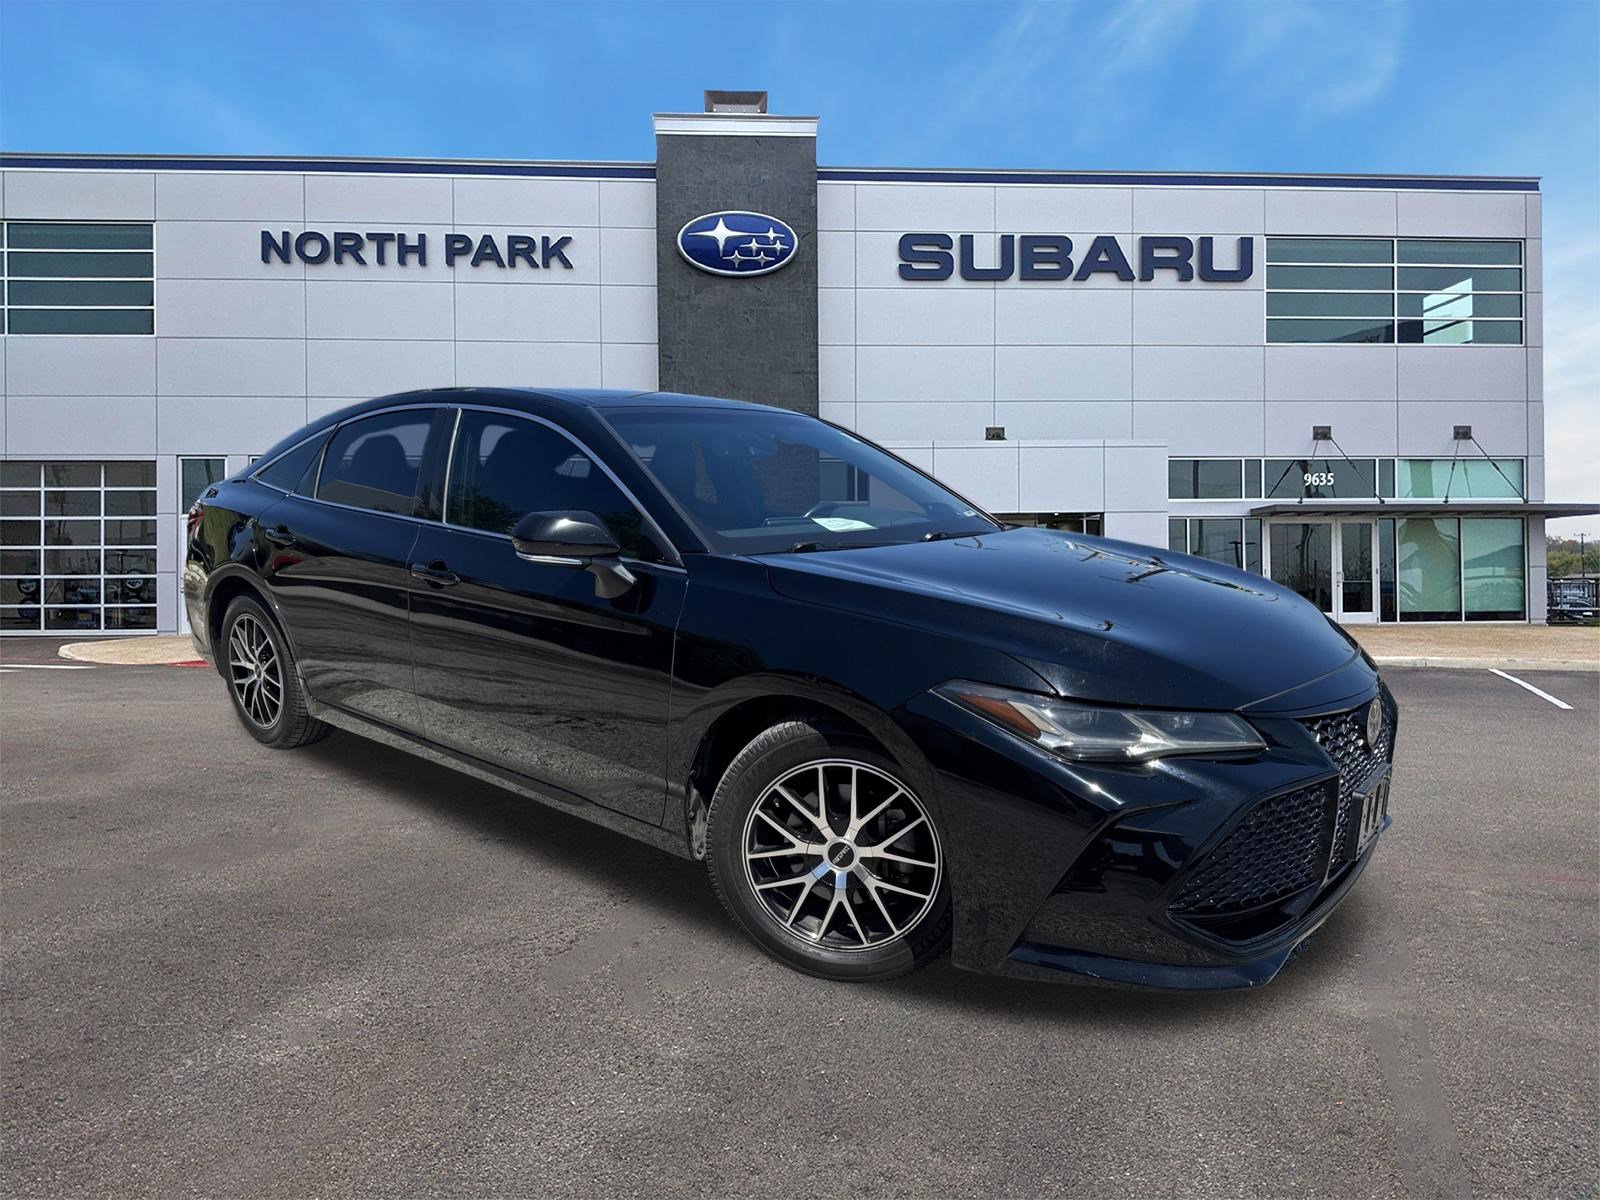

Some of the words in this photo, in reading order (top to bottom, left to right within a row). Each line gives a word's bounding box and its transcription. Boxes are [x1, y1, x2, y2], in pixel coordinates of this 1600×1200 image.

[261, 230, 427, 266] NORTH
[445, 233, 573, 269] PARK
[898, 233, 1254, 282] SUBARU
[1303, 472, 1335, 486] 9635
